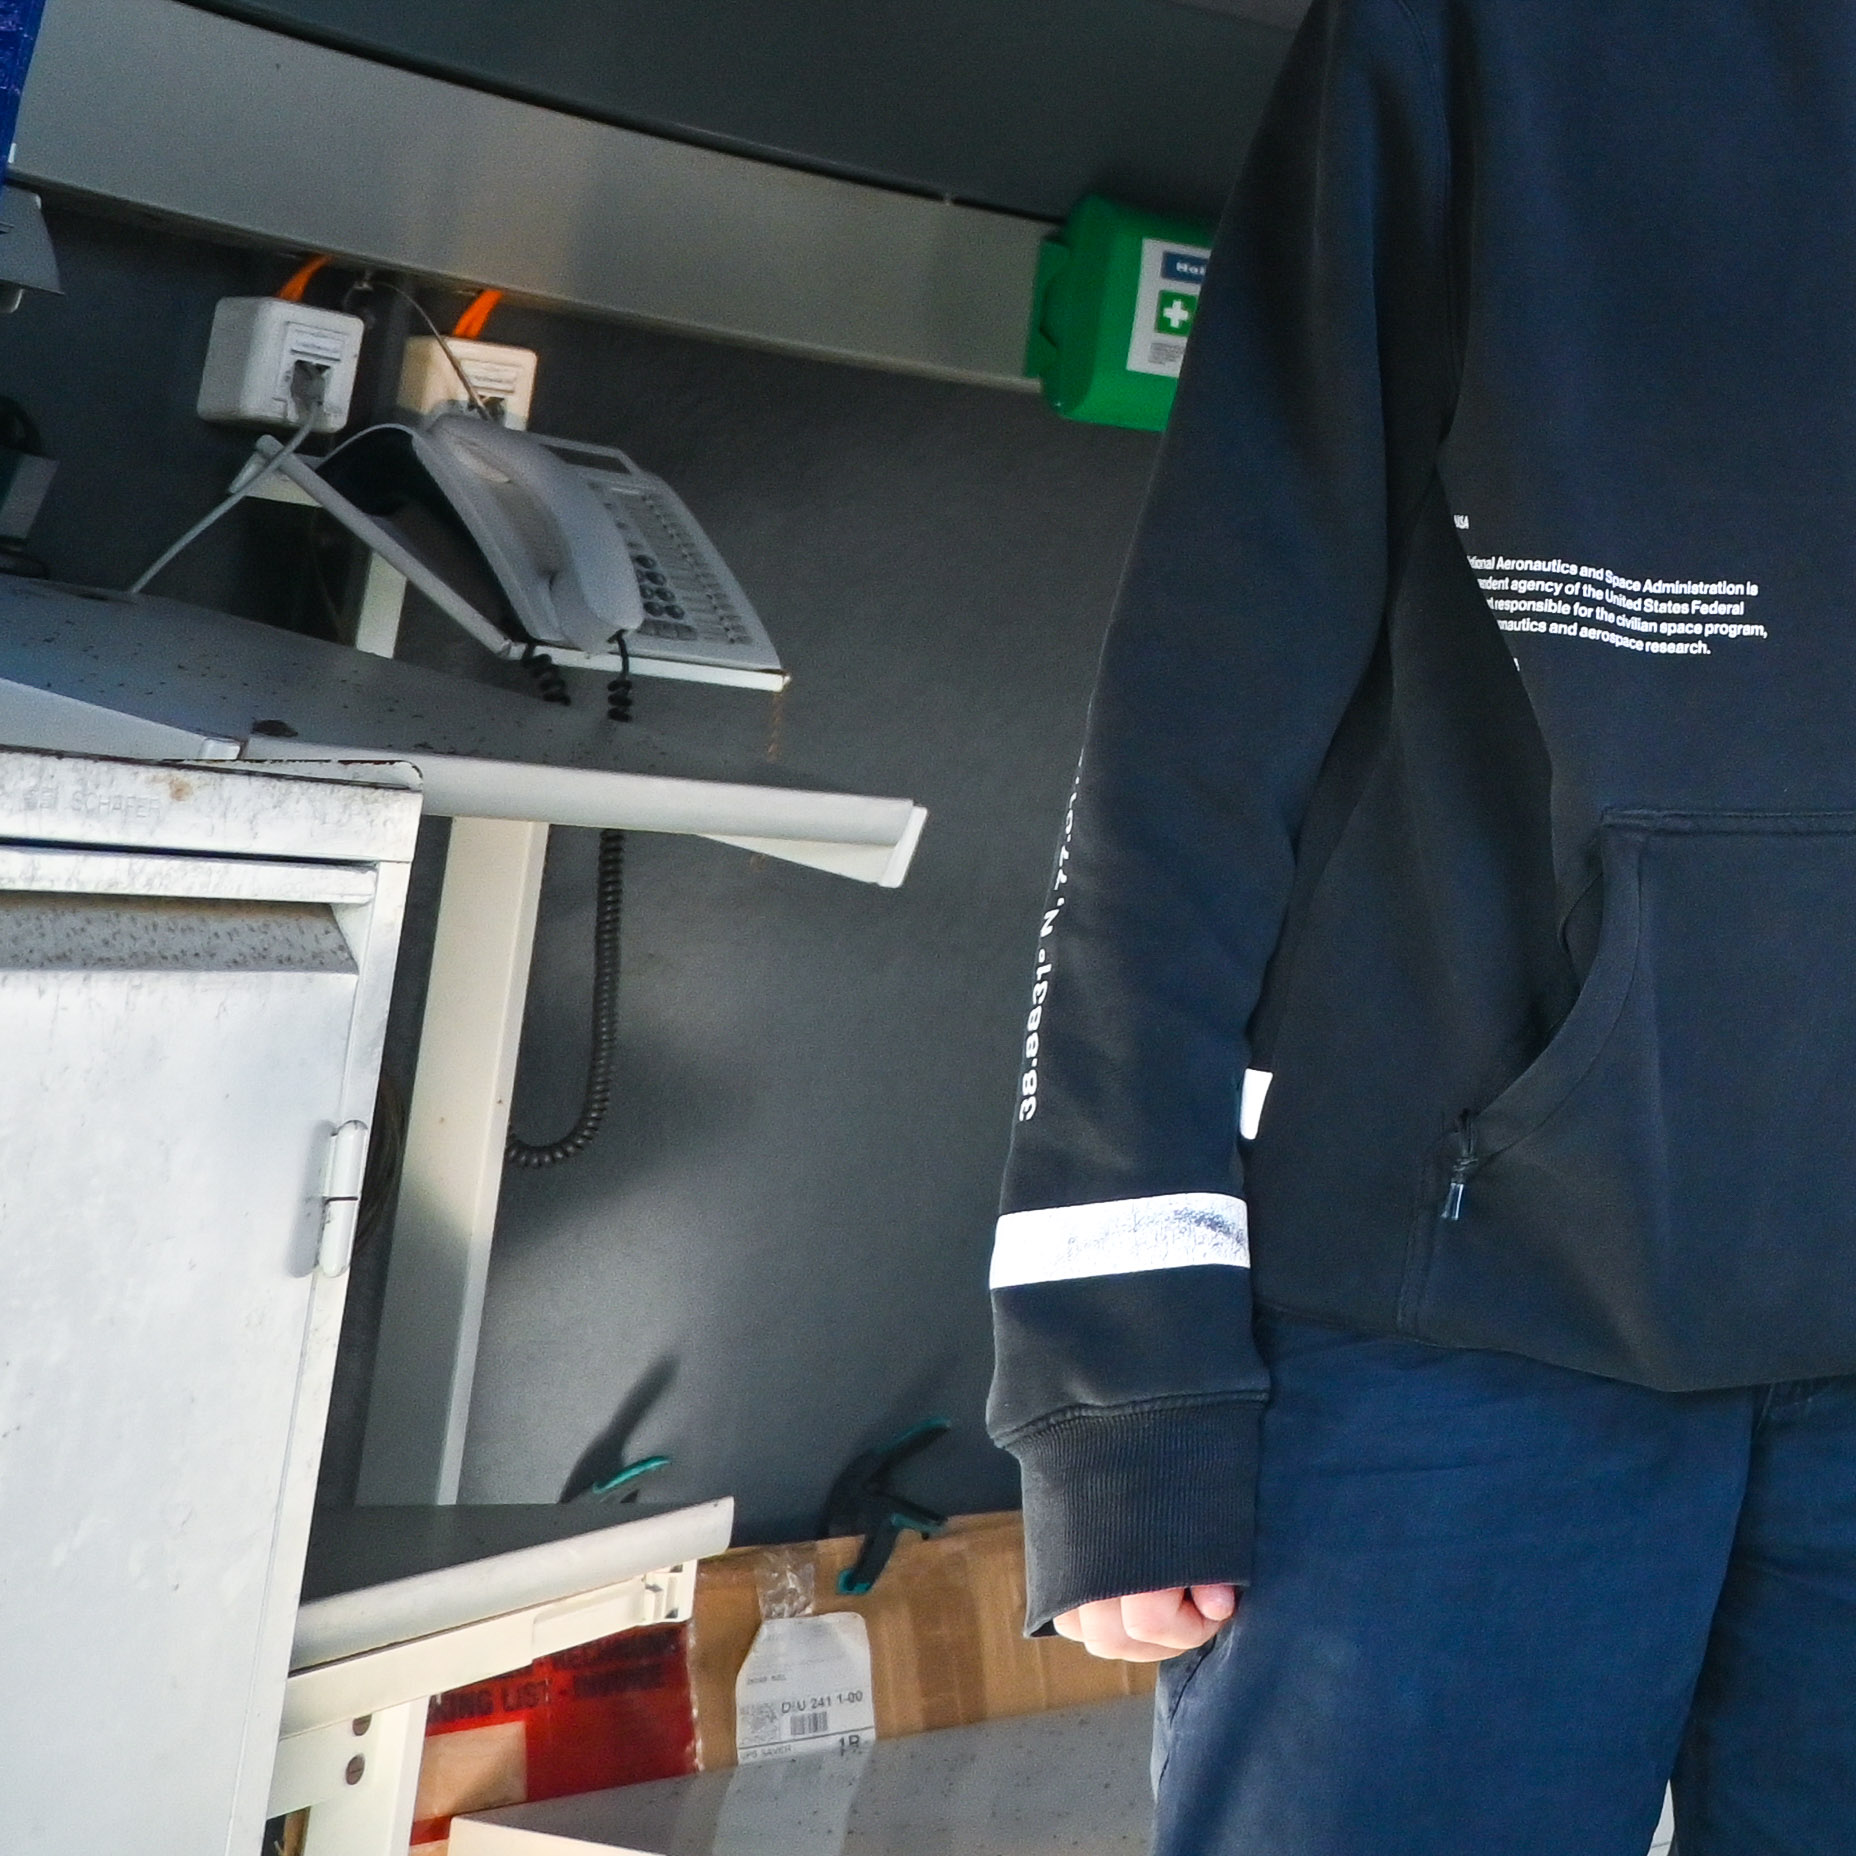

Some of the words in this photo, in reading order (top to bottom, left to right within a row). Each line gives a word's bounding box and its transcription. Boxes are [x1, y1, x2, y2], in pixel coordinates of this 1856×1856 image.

[1496, 556, 1577, 576] Aeronautics
[1580, 564, 1604, 581] and
[1605, 570, 1641, 593] Space
[1643, 579, 1745, 596] Administration
[1746, 581, 1759, 597] is
[1510, 580, 1562, 597] agency
[1564, 581, 1581, 596] of
[1582, 583, 1604, 601] the
[1605, 591, 1642, 613] United
[1644, 599, 1690, 615] States
[1691, 599, 1744, 616] Federal
[1494, 598, 1571, 617] responsible
[1573, 602, 1593, 618] for
[1595, 606, 1616, 624] the
[1616, 613, 1658, 633] civilian
[1659, 621, 1703, 638] space
[1704, 621, 1768, 639] program,
[1549, 620, 1578, 637] and
[1579, 626, 1644, 652] aerospace
[1645, 640, 1711, 655] research.
[1019, 948, 1051, 1121] 38.8831°
[1040, 897, 1066, 938] N,
[811, 1695, 832, 1710] 241
